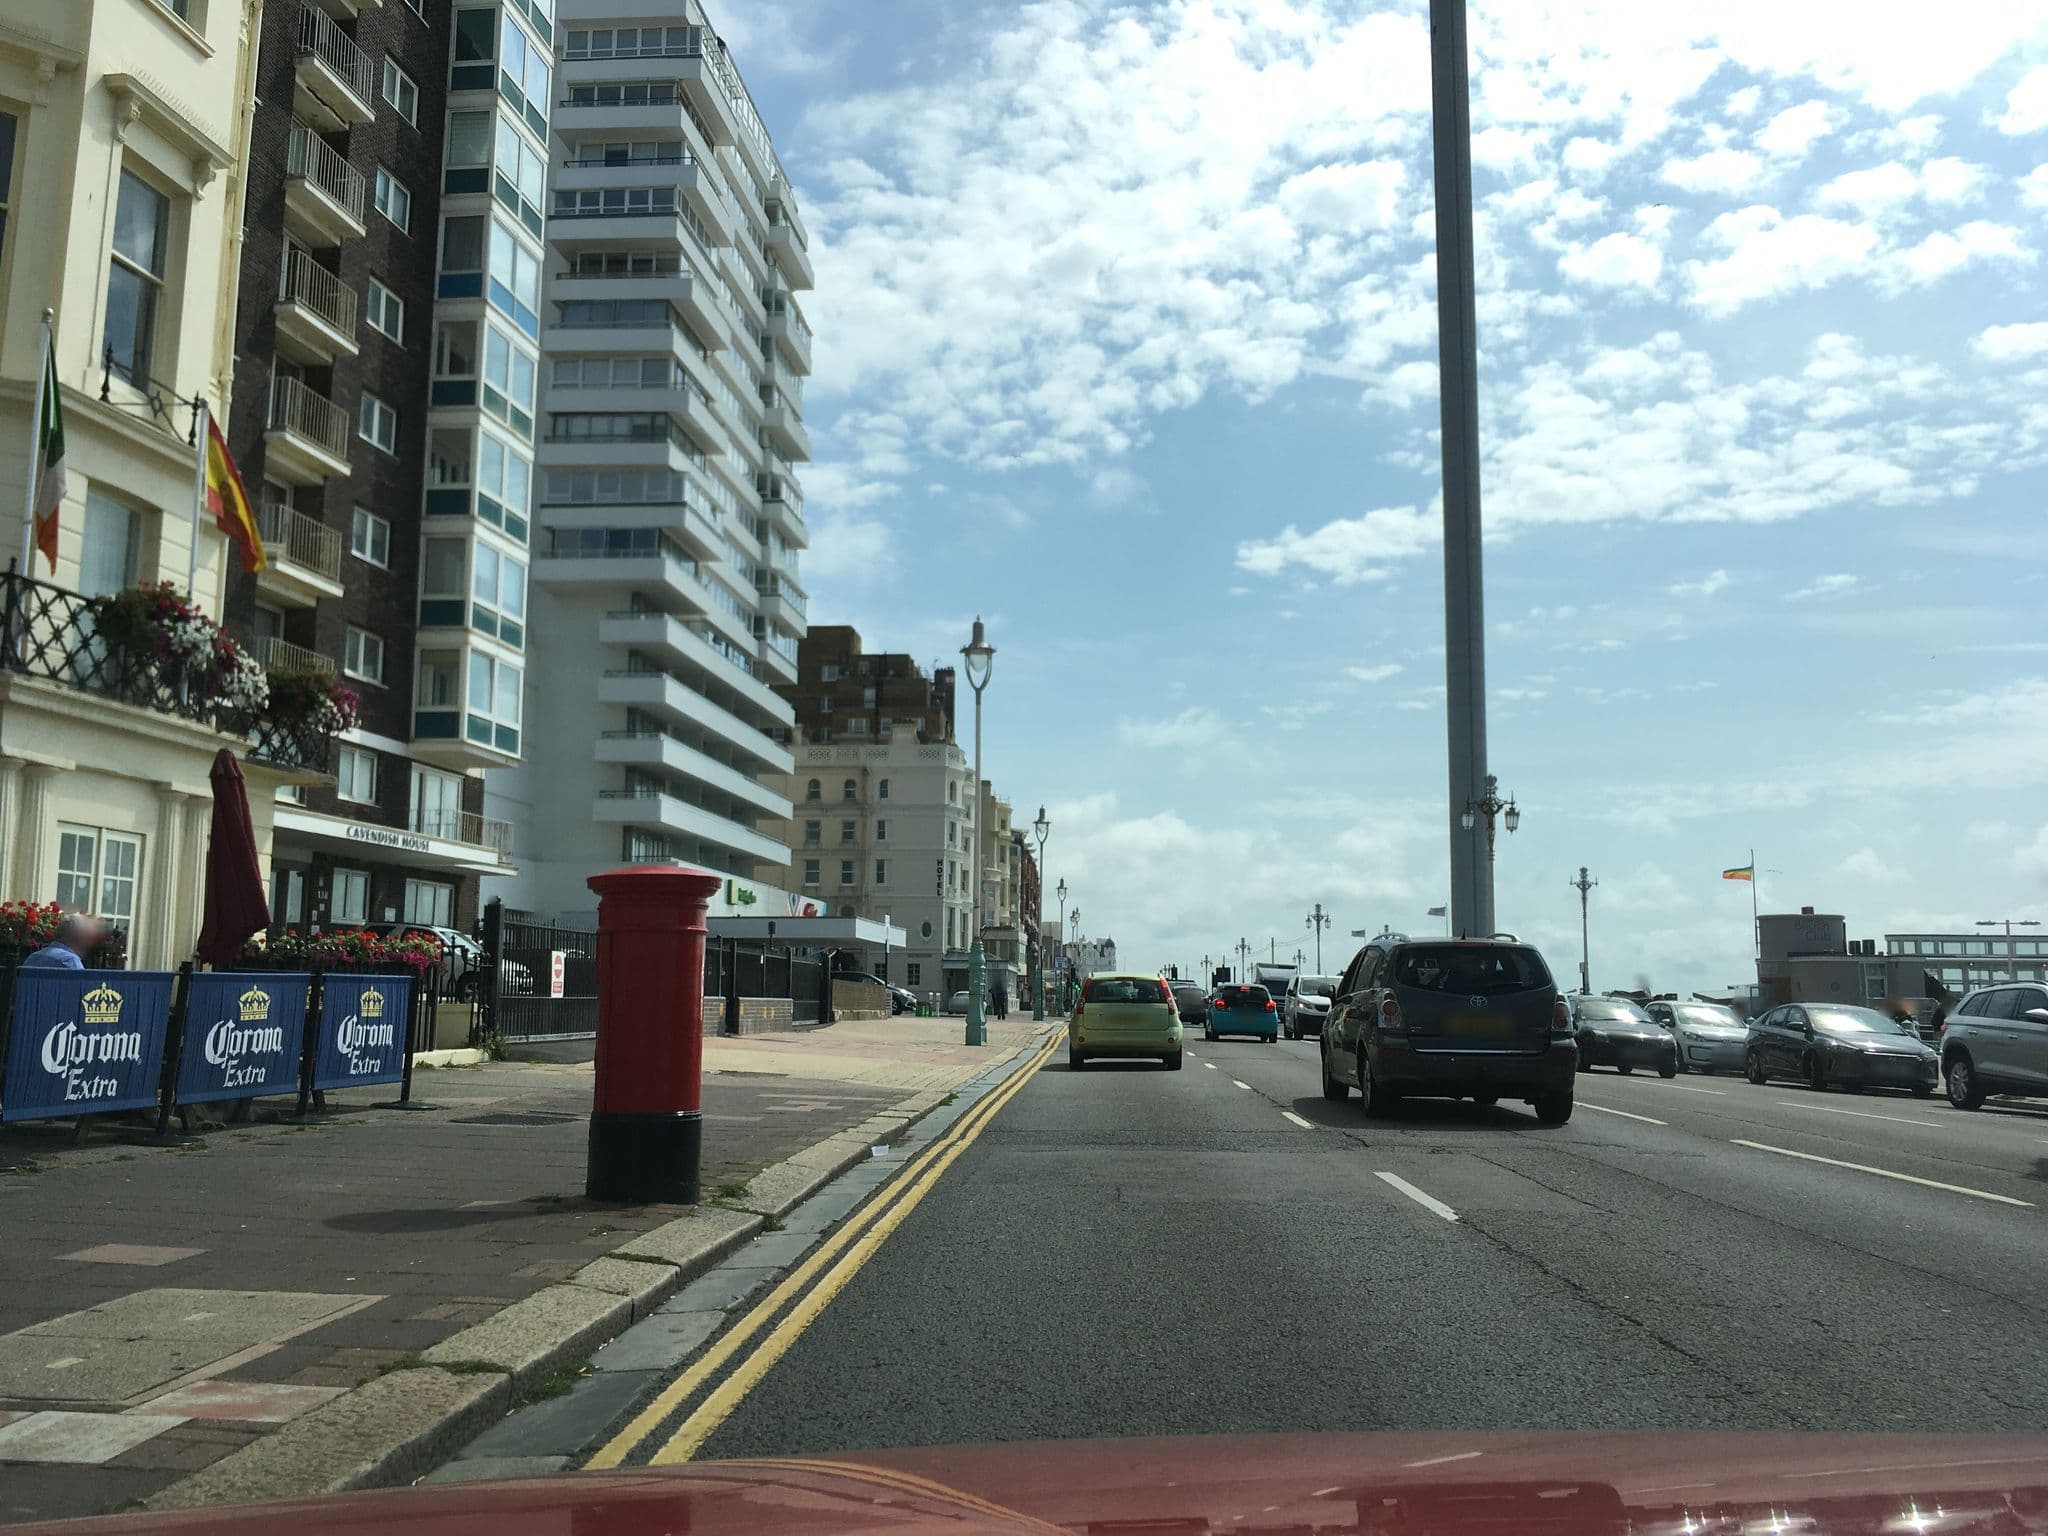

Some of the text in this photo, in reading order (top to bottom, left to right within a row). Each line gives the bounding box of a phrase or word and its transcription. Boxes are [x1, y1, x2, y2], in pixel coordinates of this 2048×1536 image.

[346, 825, 430, 851] CAVENDISH HOUSE
[41, 1021, 141, 1079] Corona
[205, 1019, 283, 1069] Corona
[337, 1014, 394, 1058] Corona
[223, 1059, 266, 1088] Extra
[351, 1050, 381, 1075] Extra
[64, 1068, 118, 1100] Extra
